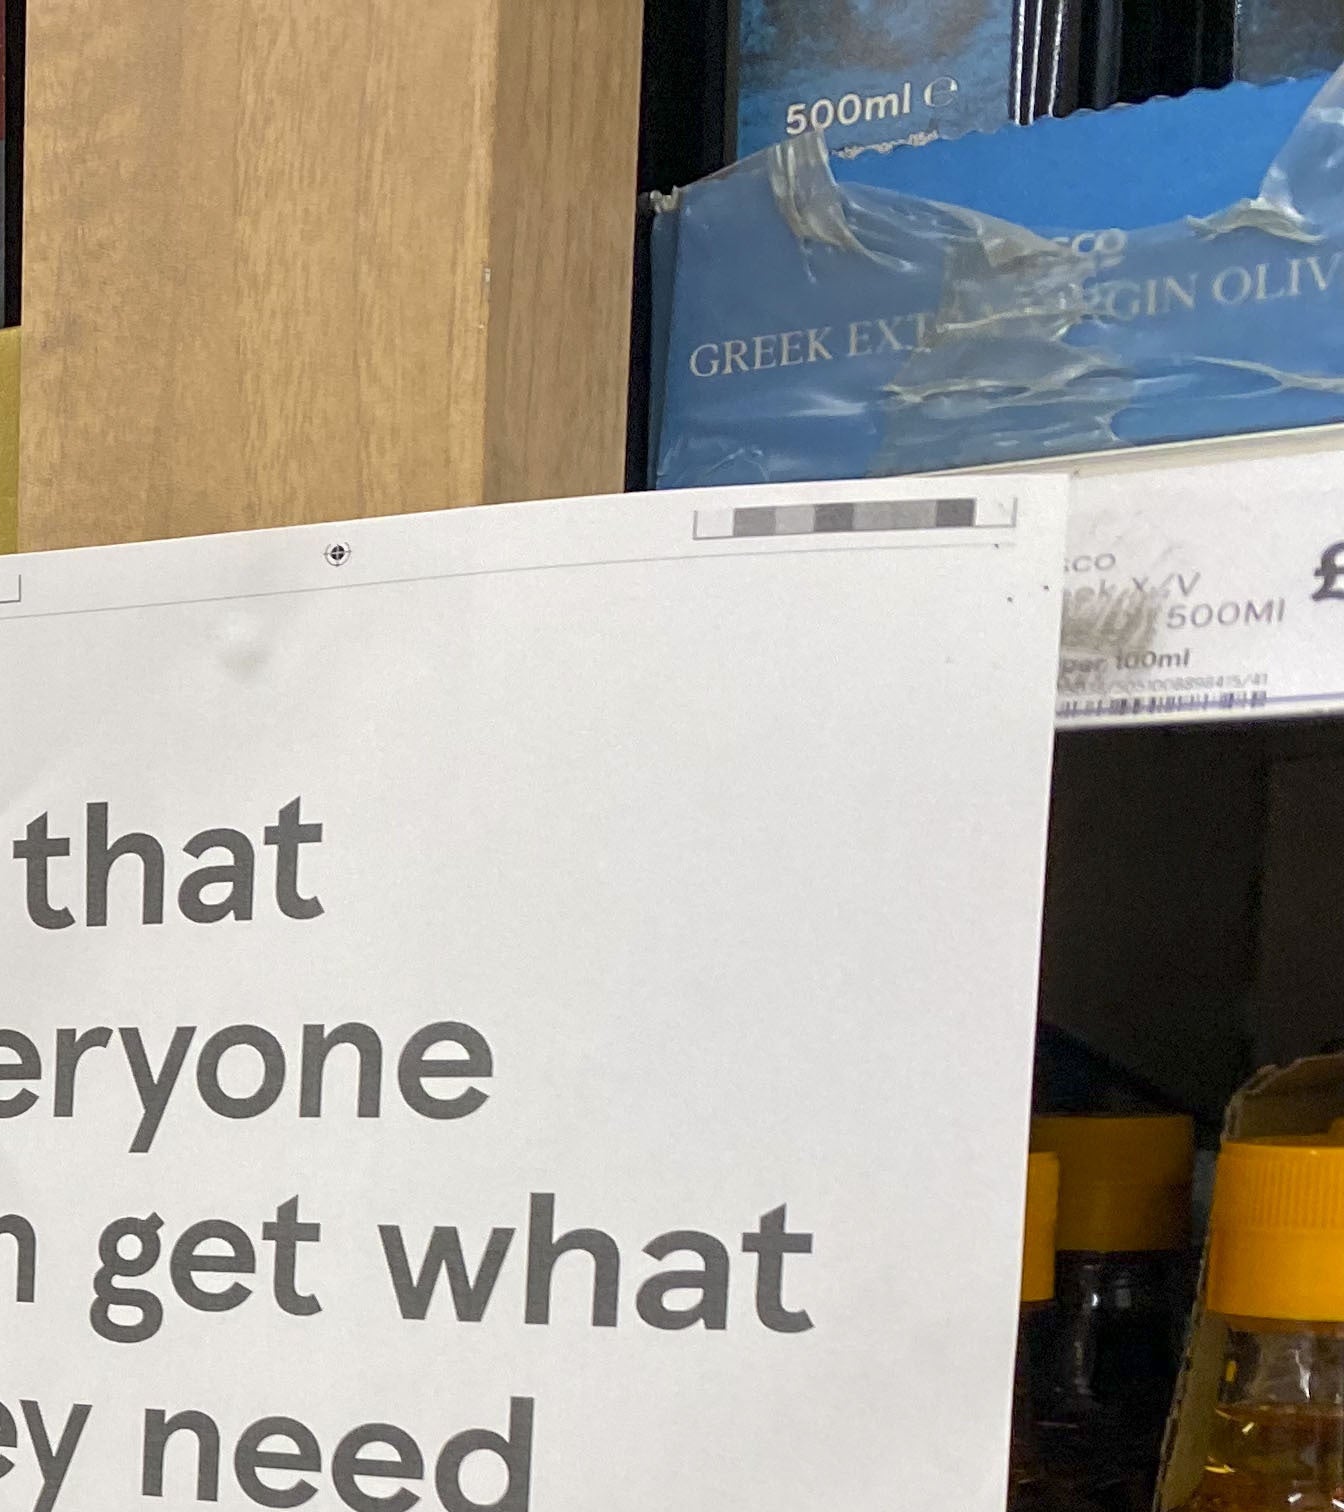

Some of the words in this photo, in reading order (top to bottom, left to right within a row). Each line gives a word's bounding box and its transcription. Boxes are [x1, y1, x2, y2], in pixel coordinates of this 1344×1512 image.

[786, 82, 911, 135] 500ml
[689, 322, 834, 379] GREEK
[10, 795, 326, 930] that
[88, 1192, 324, 1344] get
[376, 1191, 817, 1333] what
